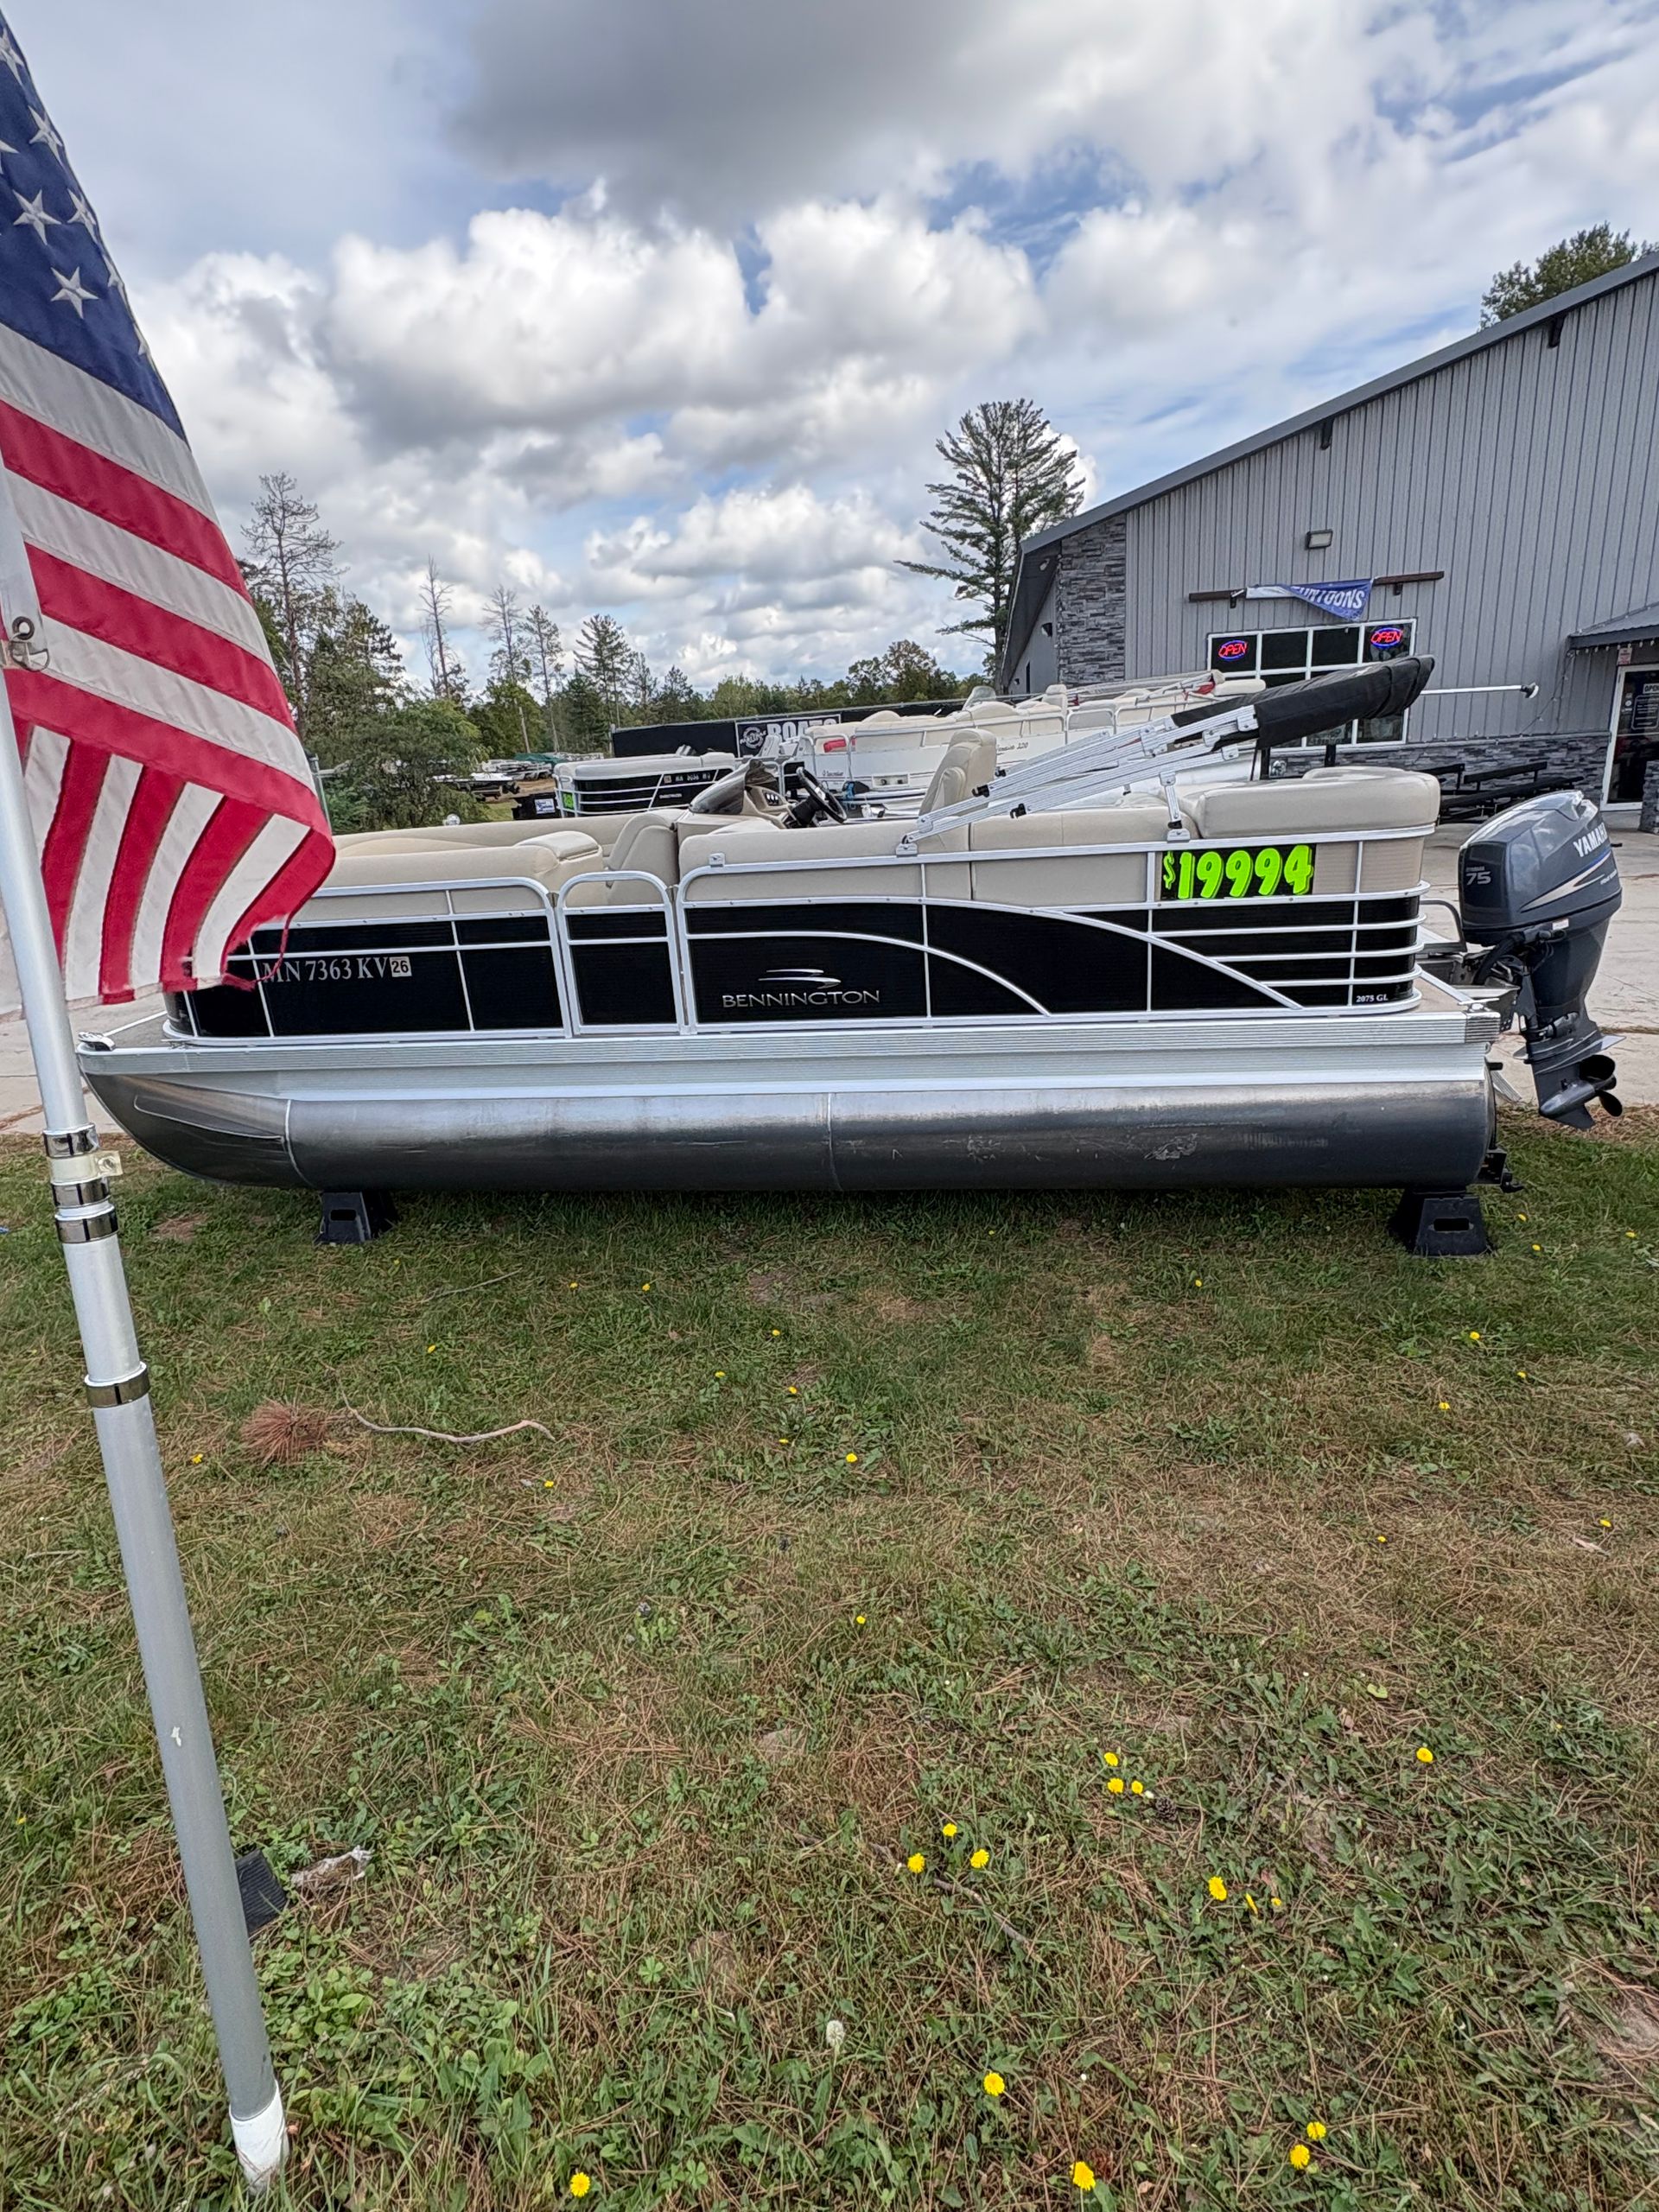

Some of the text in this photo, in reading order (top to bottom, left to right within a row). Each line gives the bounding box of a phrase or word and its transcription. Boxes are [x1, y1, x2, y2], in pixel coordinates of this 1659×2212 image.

[1370, 628, 1404, 645] OPEN
[1218, 641, 1249, 658] OPEN
[766, 718, 837, 741] BOA
[1573, 822, 1608, 857] YAMAH
[1163, 844, 1314, 899] $19994
[1465, 871, 1491, 886] 75
[263, 957, 388, 982] MN 7363 KV
[391, 960, 409, 974] 26
[721, 990, 880, 1008] BENNINGTON
